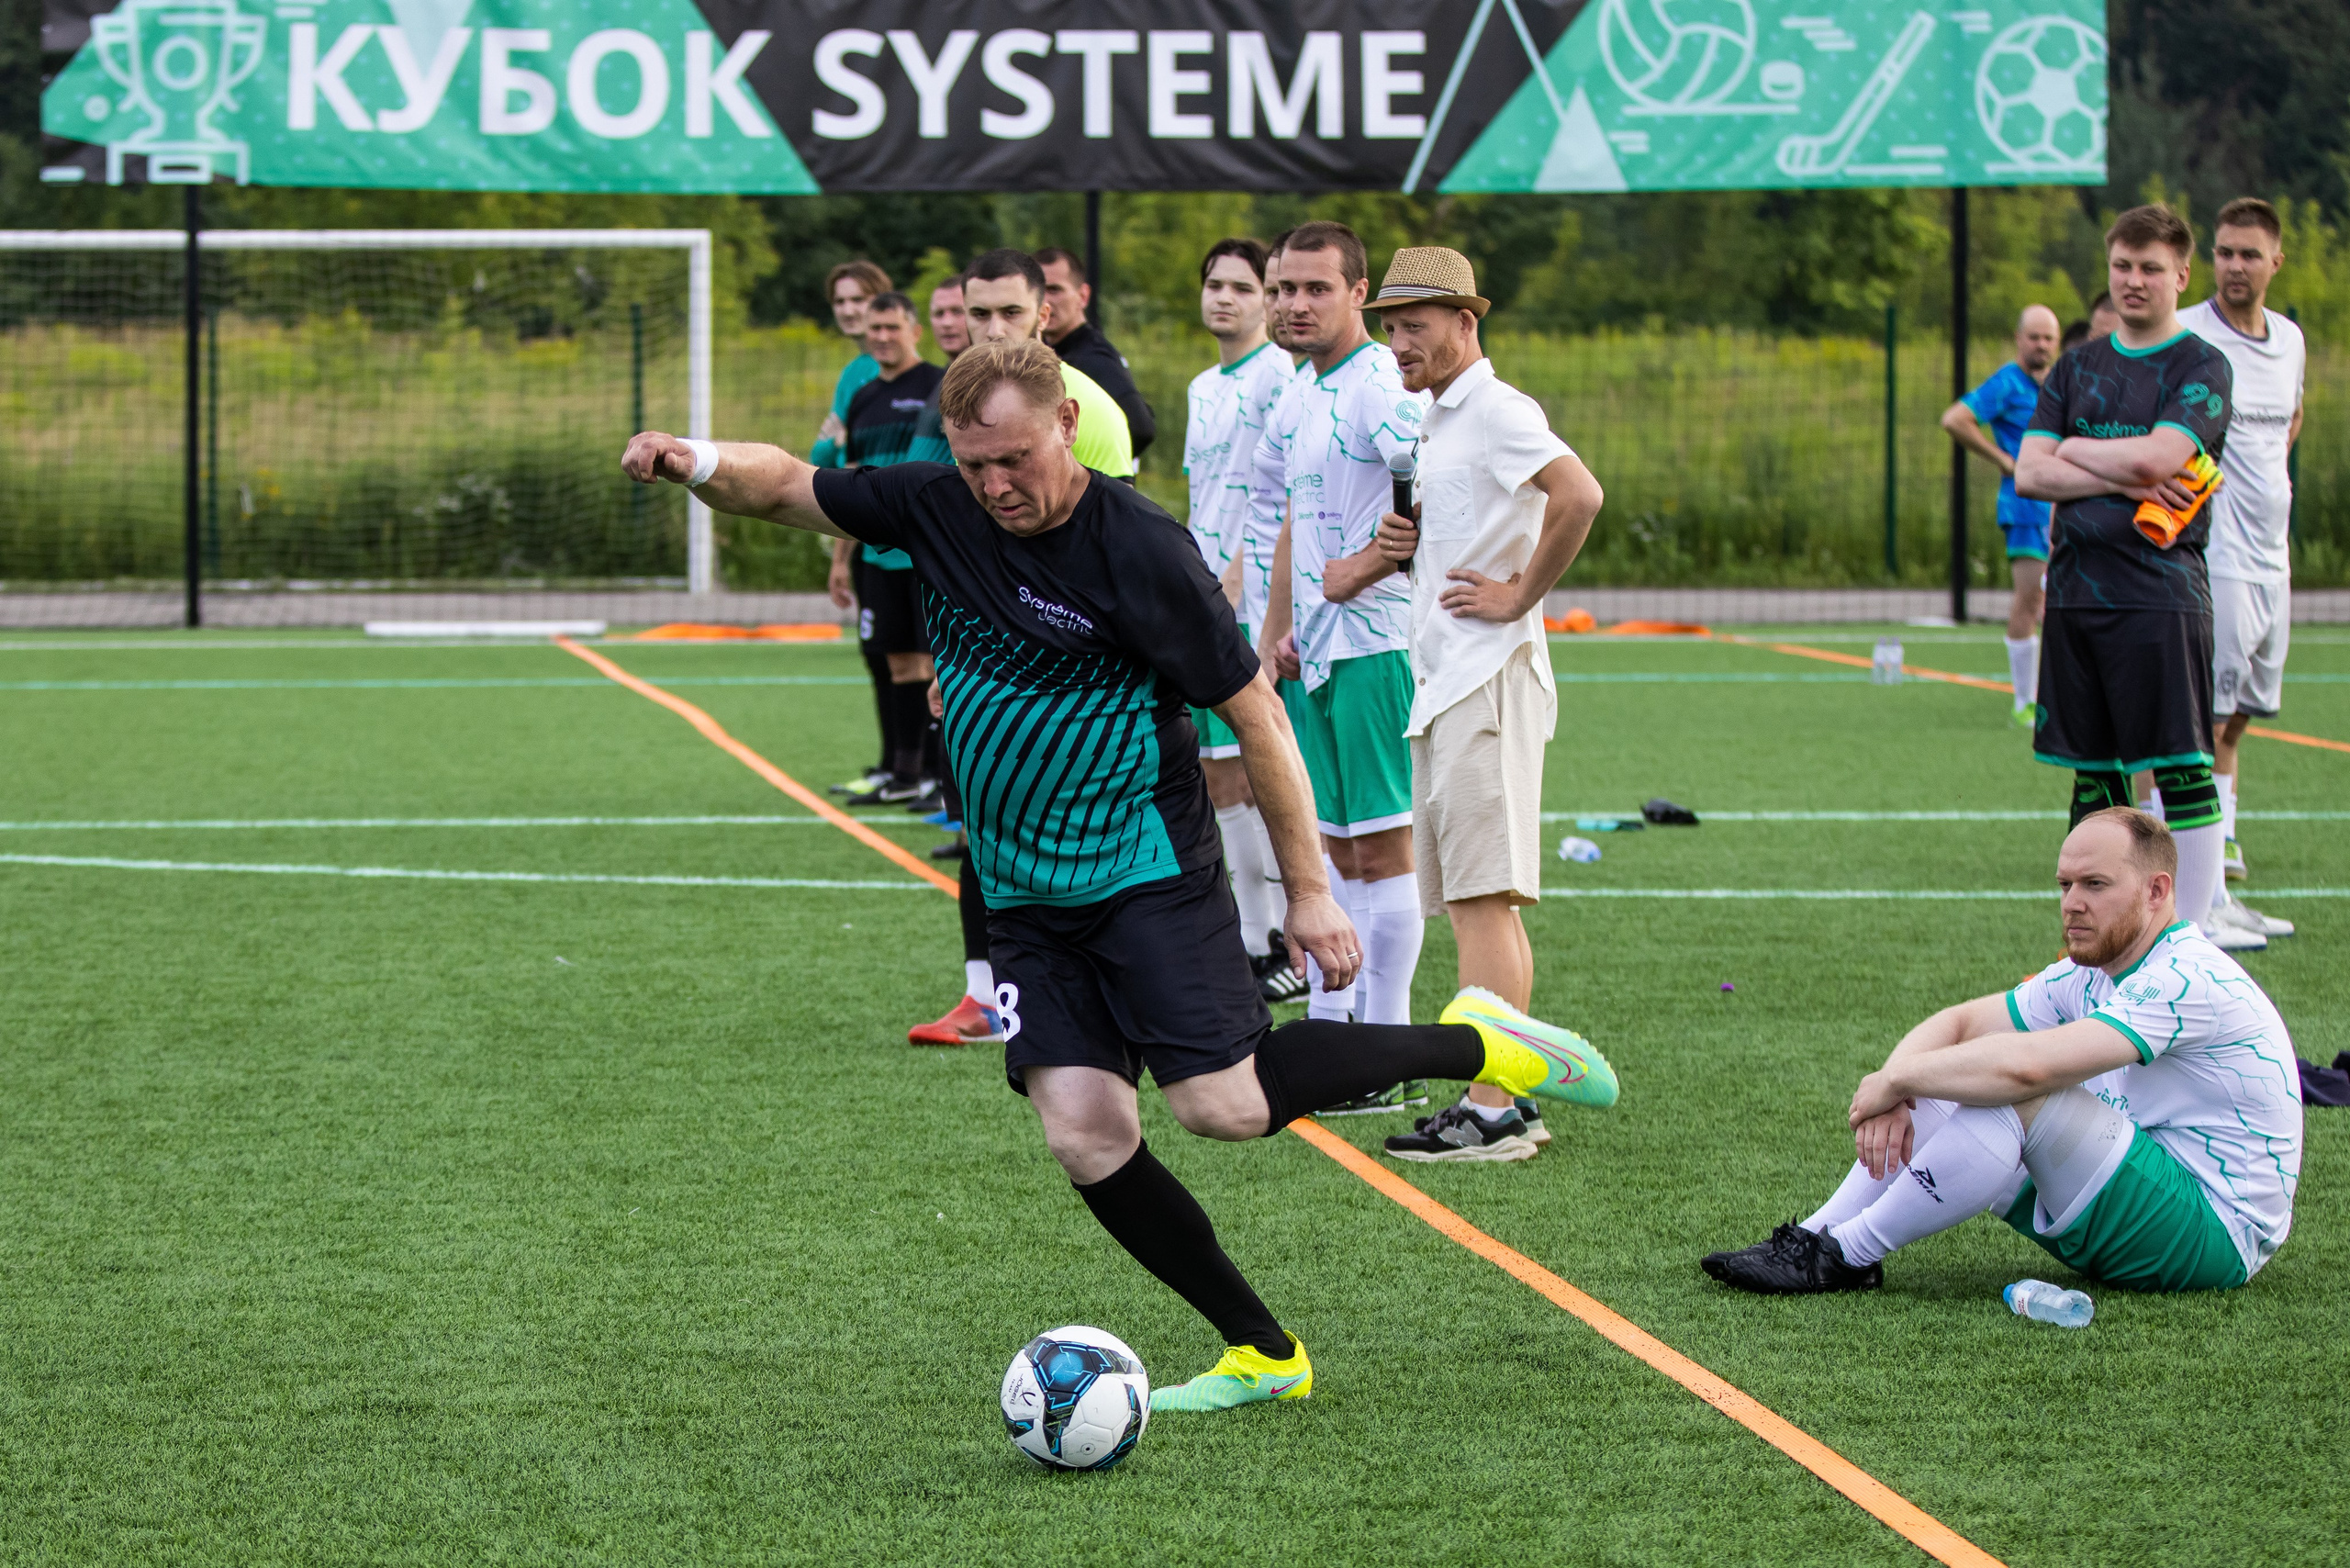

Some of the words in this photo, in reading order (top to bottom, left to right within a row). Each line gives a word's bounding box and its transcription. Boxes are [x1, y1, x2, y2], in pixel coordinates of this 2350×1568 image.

[287, 24, 772, 139] КУБОК
[811, 28, 1427, 140] SYSTEME
[995, 982, 1021, 1043] 8
